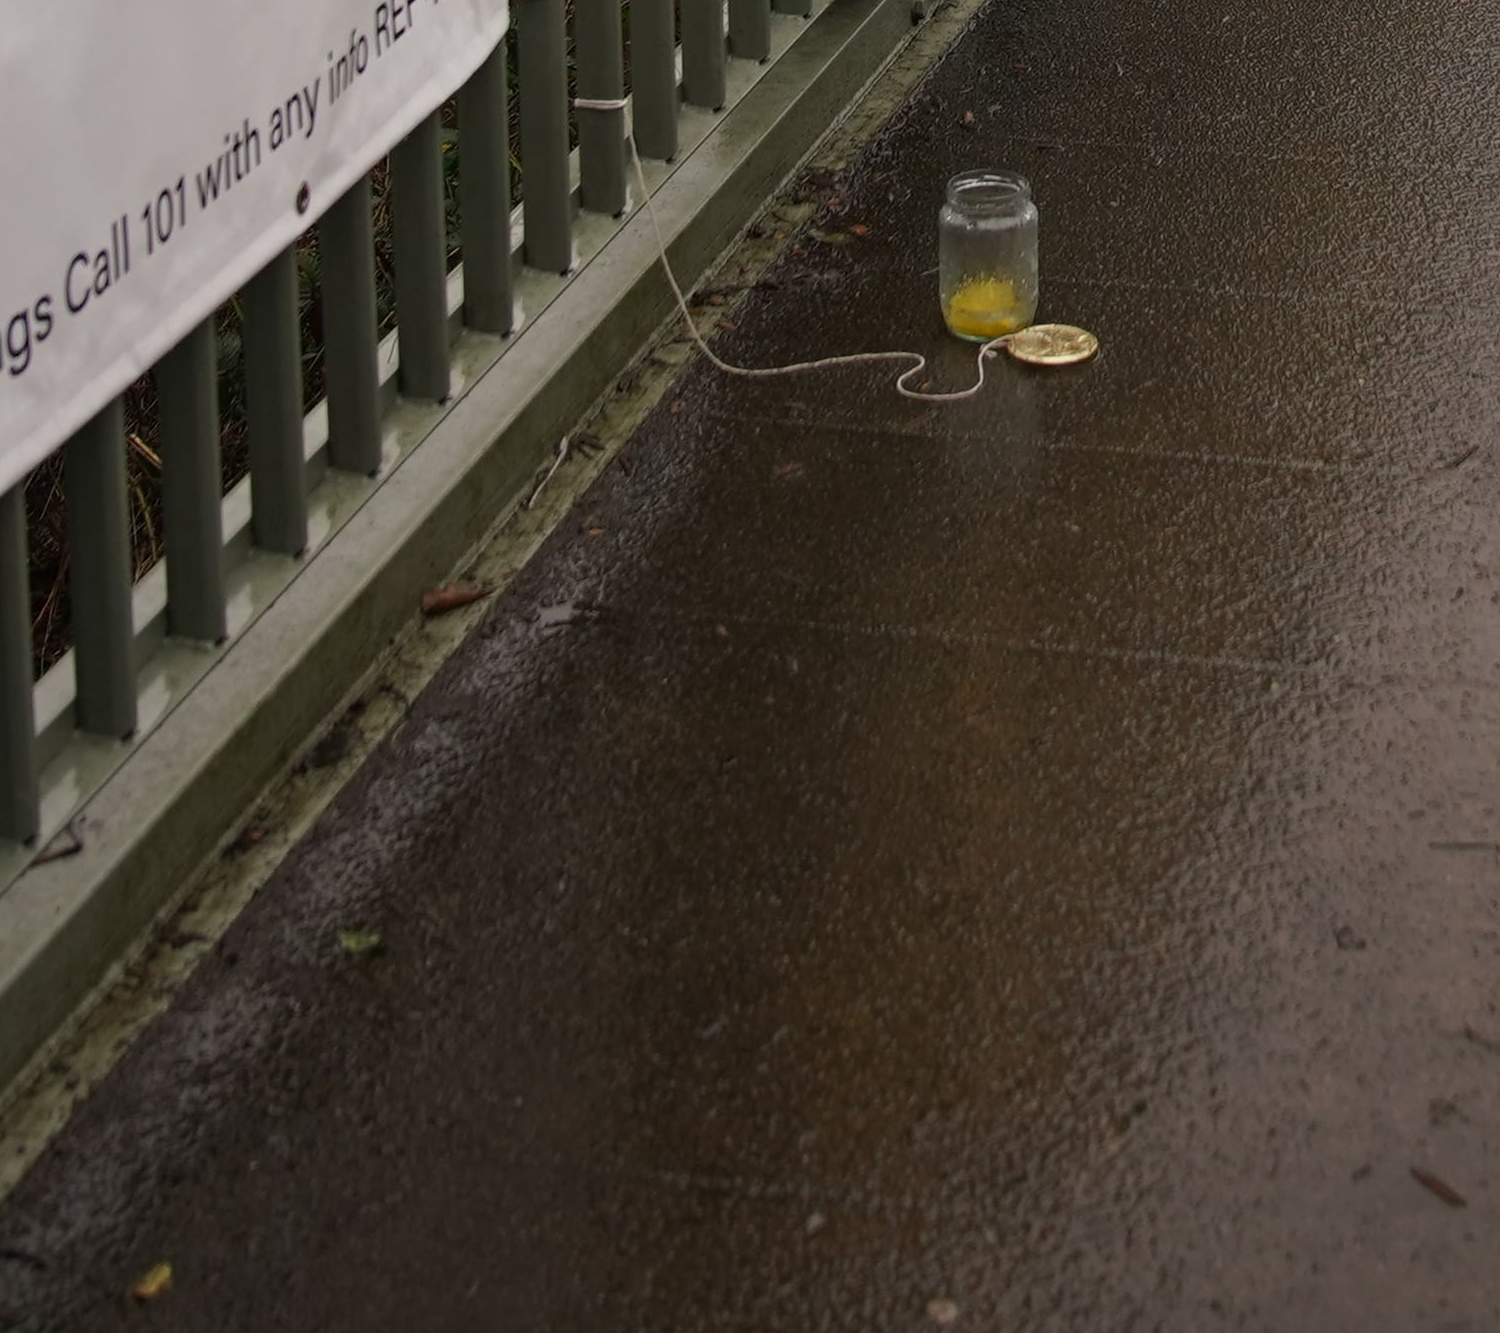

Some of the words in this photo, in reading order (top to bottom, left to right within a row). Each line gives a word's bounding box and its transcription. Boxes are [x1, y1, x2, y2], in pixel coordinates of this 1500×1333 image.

[63, 212, 131, 318] Call
[139, 174, 188, 257] 101
[195, 118, 262, 210] with
[268, 76, 322, 152] any
[327, 27, 370, 106] info
